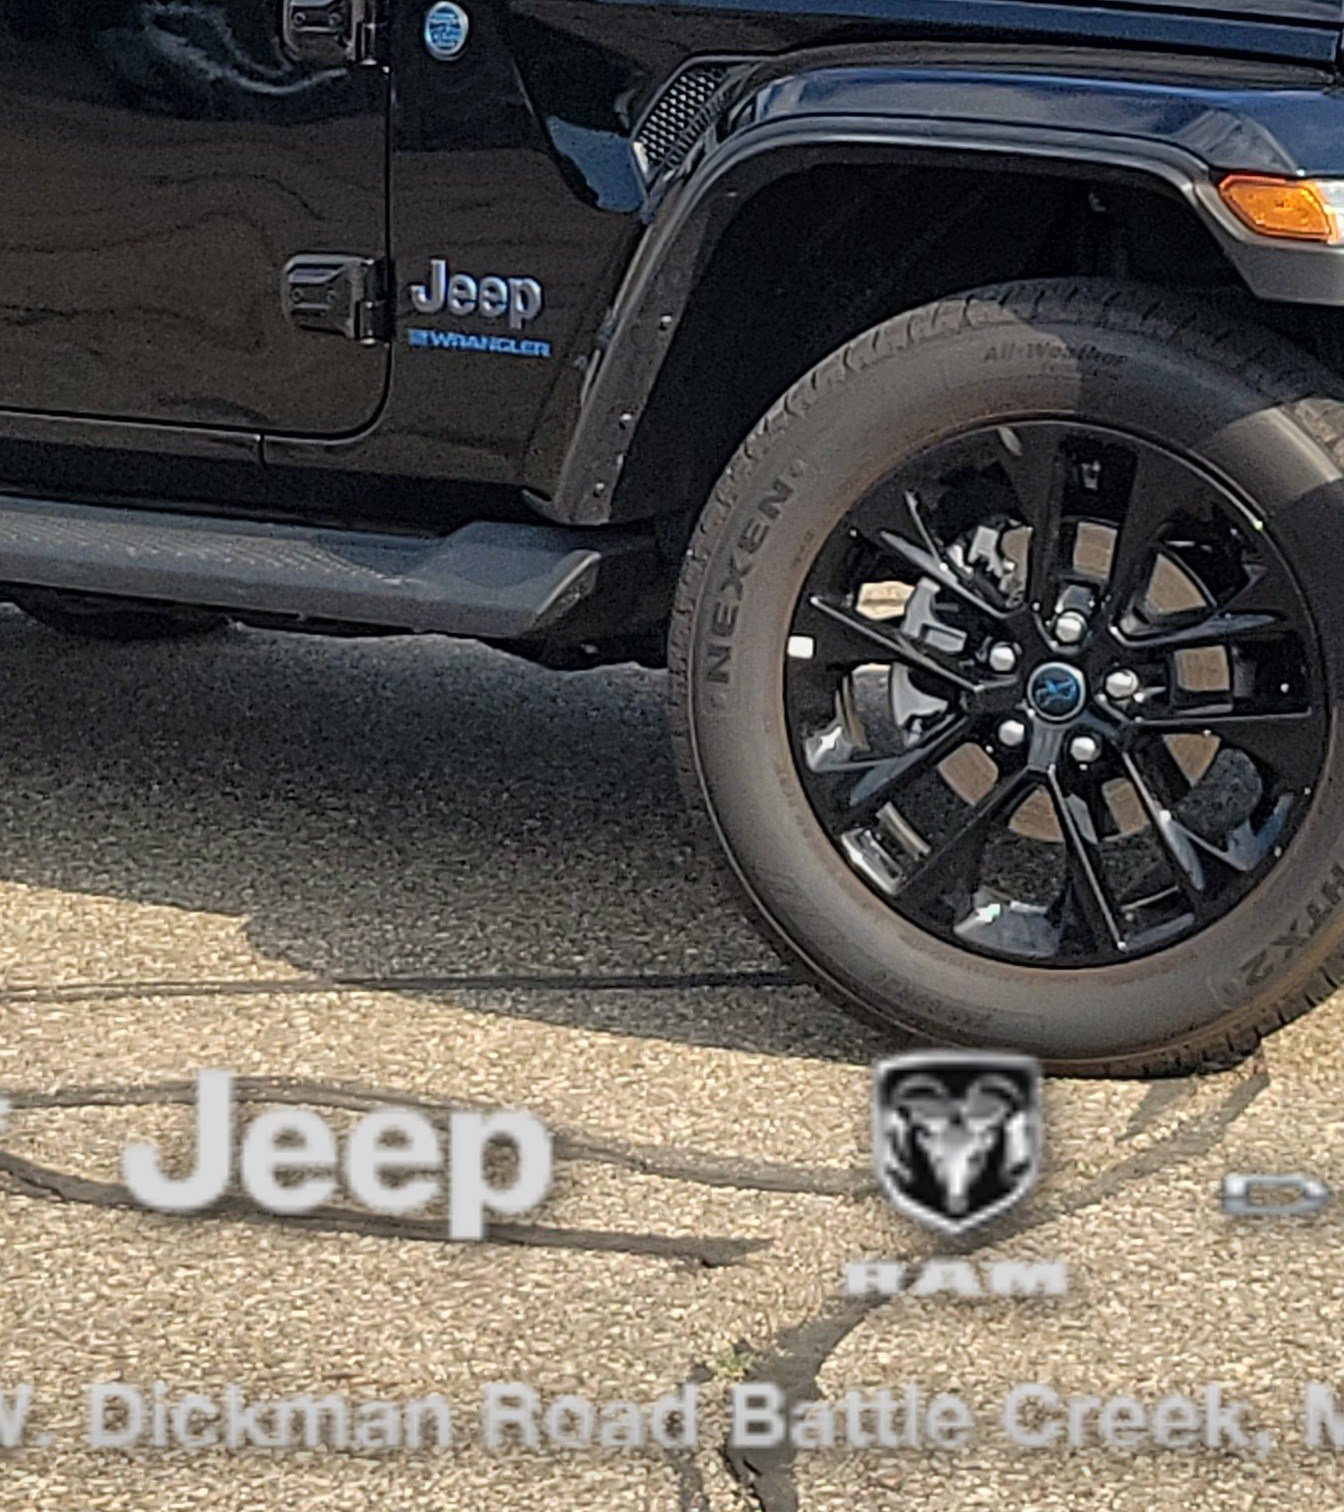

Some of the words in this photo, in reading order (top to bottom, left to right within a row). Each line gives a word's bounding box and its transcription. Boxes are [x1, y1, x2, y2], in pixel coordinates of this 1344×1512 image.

[410, 259, 542, 330] Jeep
[430, 331, 551, 358] WRANGLER
[705, 478, 795, 684] NEXEN
